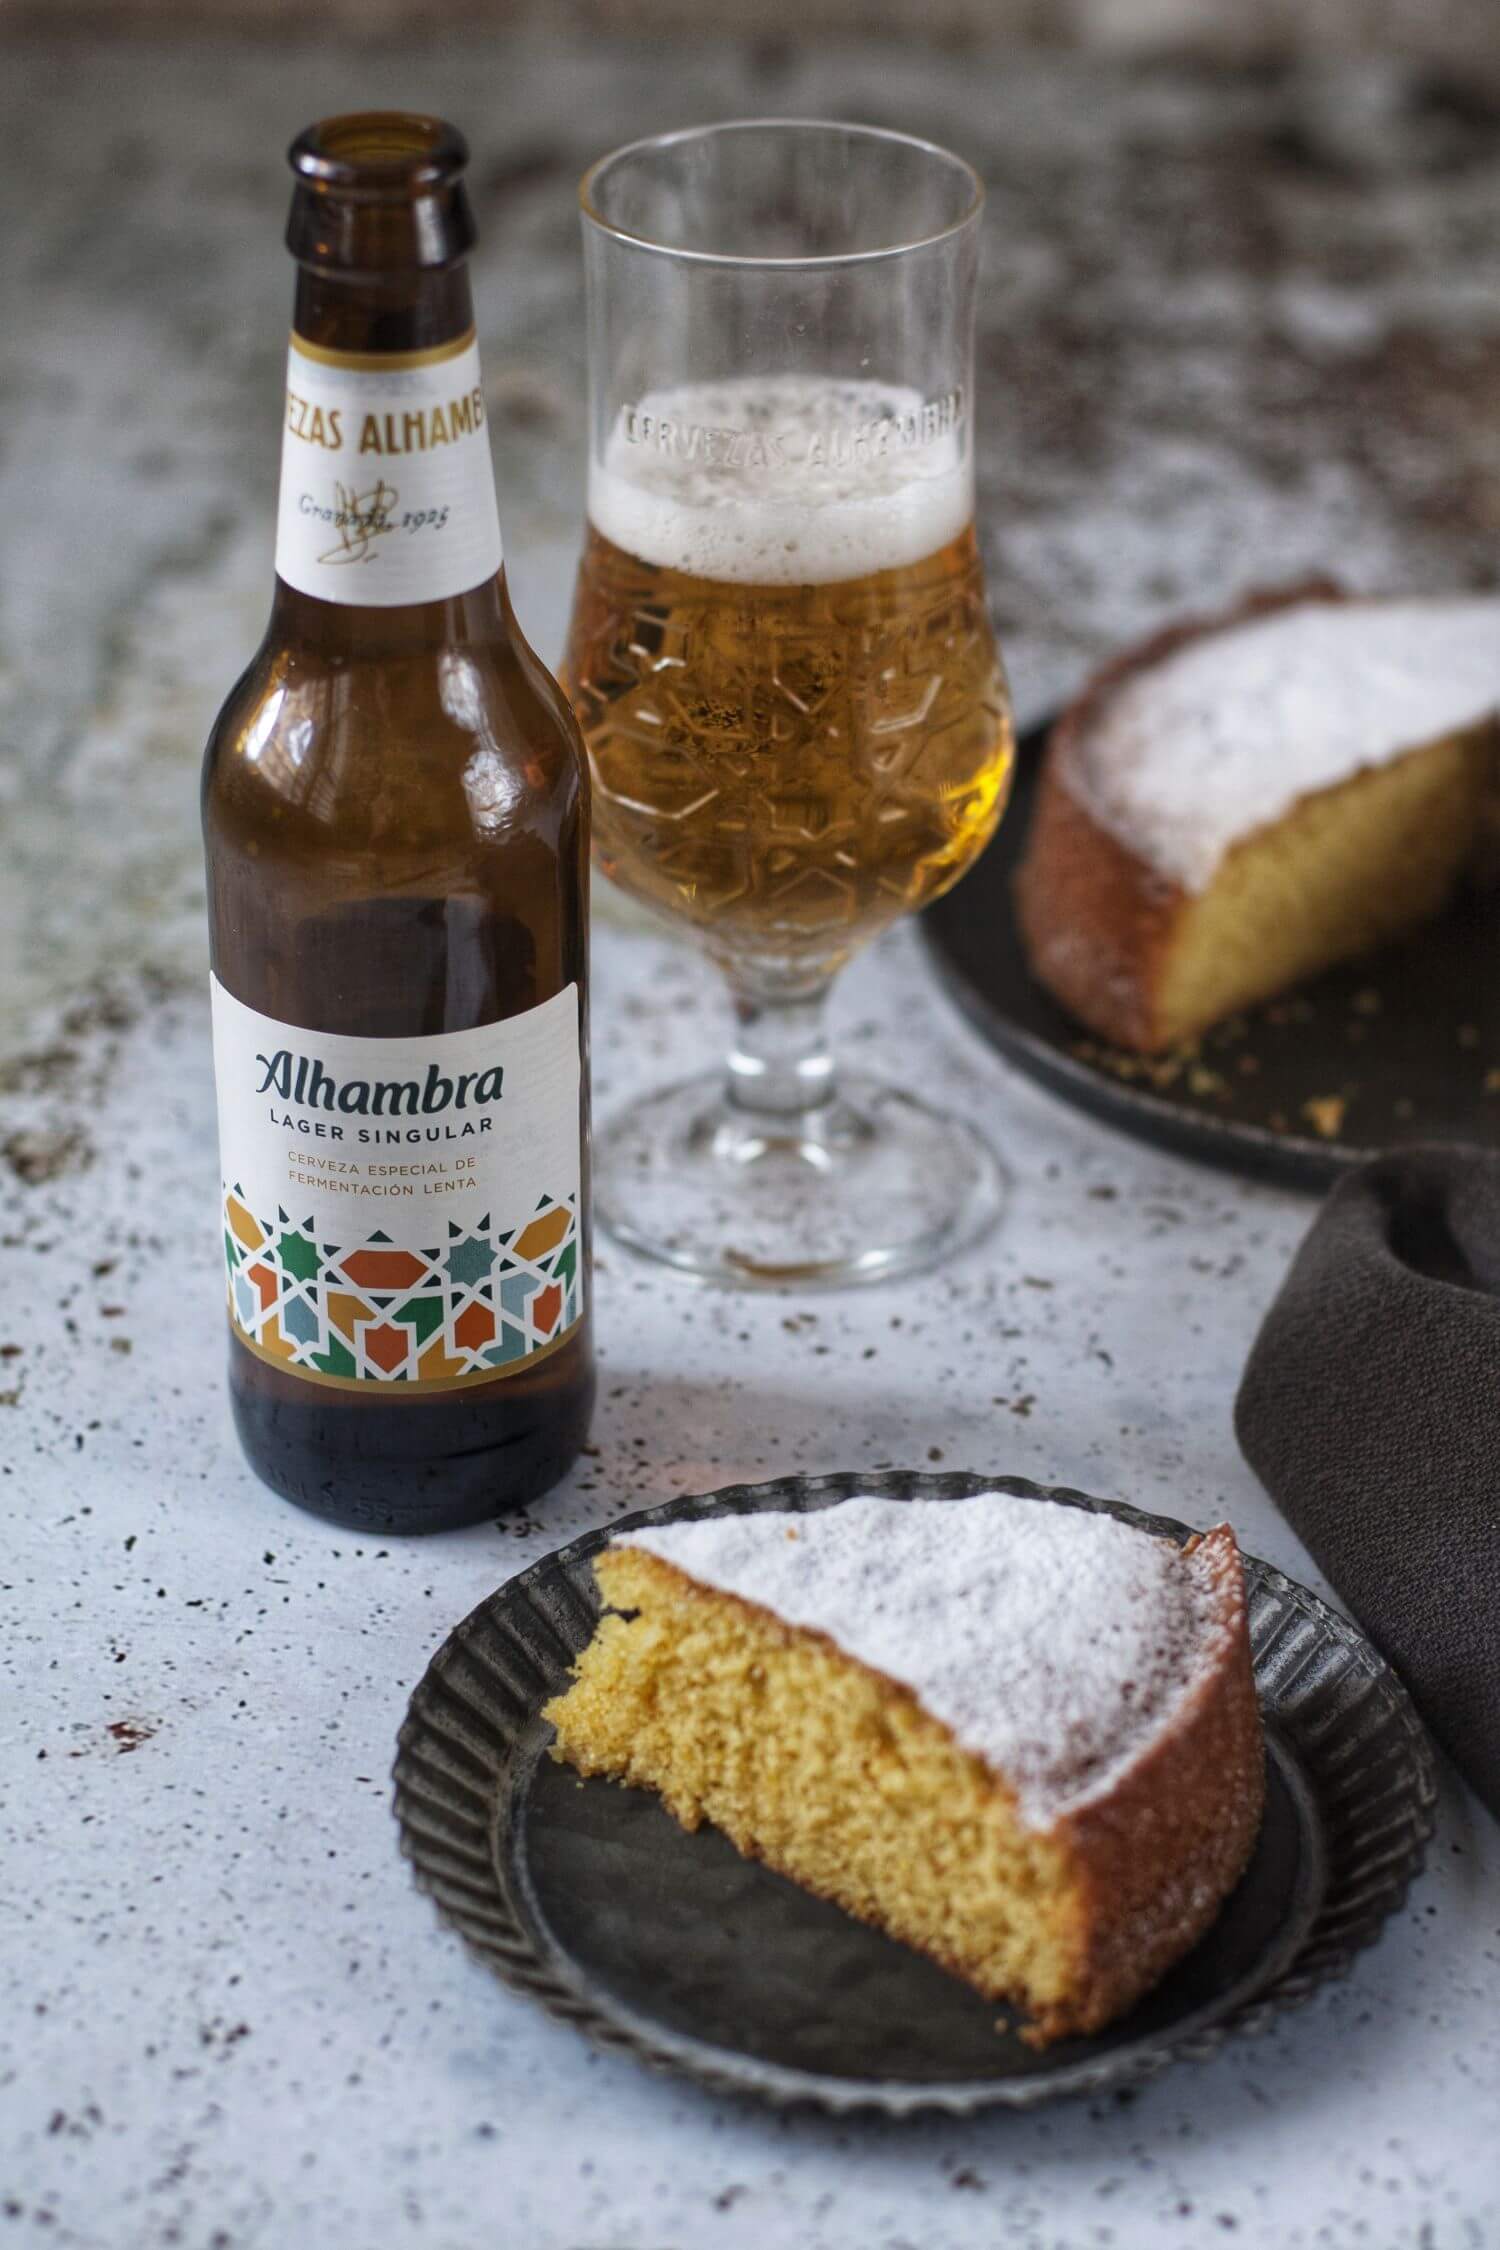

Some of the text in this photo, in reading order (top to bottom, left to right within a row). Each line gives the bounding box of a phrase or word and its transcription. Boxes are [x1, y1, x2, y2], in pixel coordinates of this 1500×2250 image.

[256, 1050, 504, 1115] Alhambra
[270, 1108, 493, 1144] LAGER SINGULAR
[288, 1151, 476, 1176] CERVEZA ESPECIAL DE
[288, 1170, 477, 1196] FERMENTACIÓN LENTA
